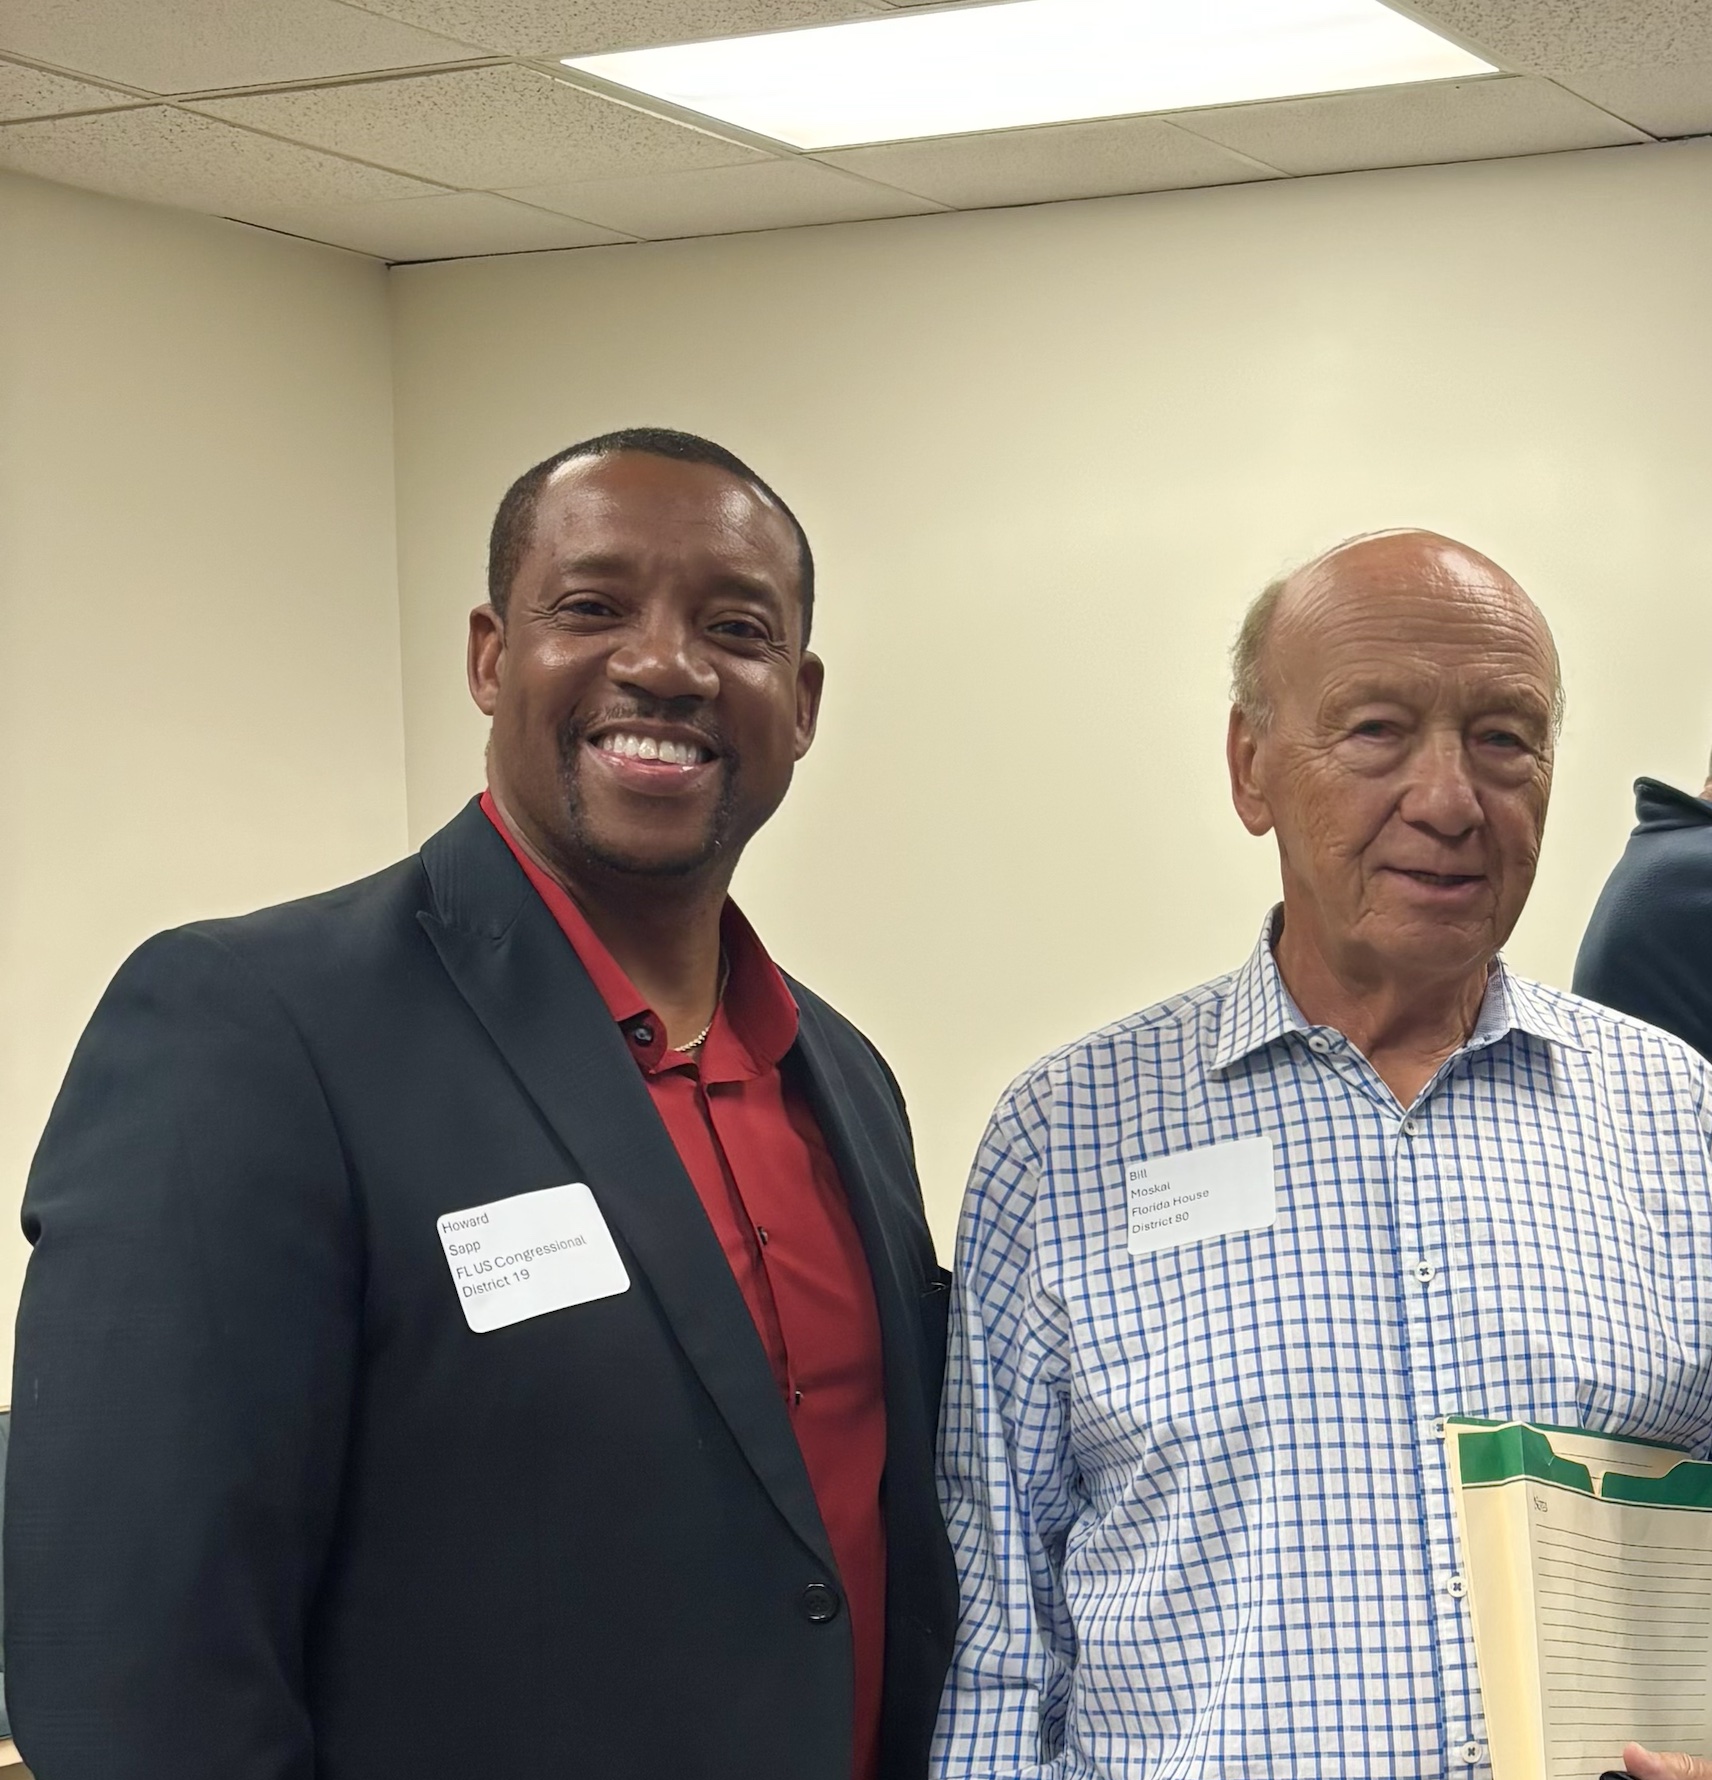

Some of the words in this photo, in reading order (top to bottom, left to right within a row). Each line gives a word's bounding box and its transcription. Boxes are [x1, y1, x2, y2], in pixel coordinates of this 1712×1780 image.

[1129, 1169, 1148, 1181] Bill
[1131, 1200, 1170, 1217] Florida
[1173, 1189, 1209, 1206] House
[441, 1212, 490, 1234] Howard
[1132, 1217, 1173, 1234] District
[1175, 1211, 1190, 1224] 80
[448, 1240, 481, 1257] Sapp
[456, 1266, 473, 1280] FL
[473, 1259, 493, 1275] US
[494, 1234, 588, 1269] Congressional
[461, 1275, 511, 1299] District
[513, 1268, 530, 1283] 19
